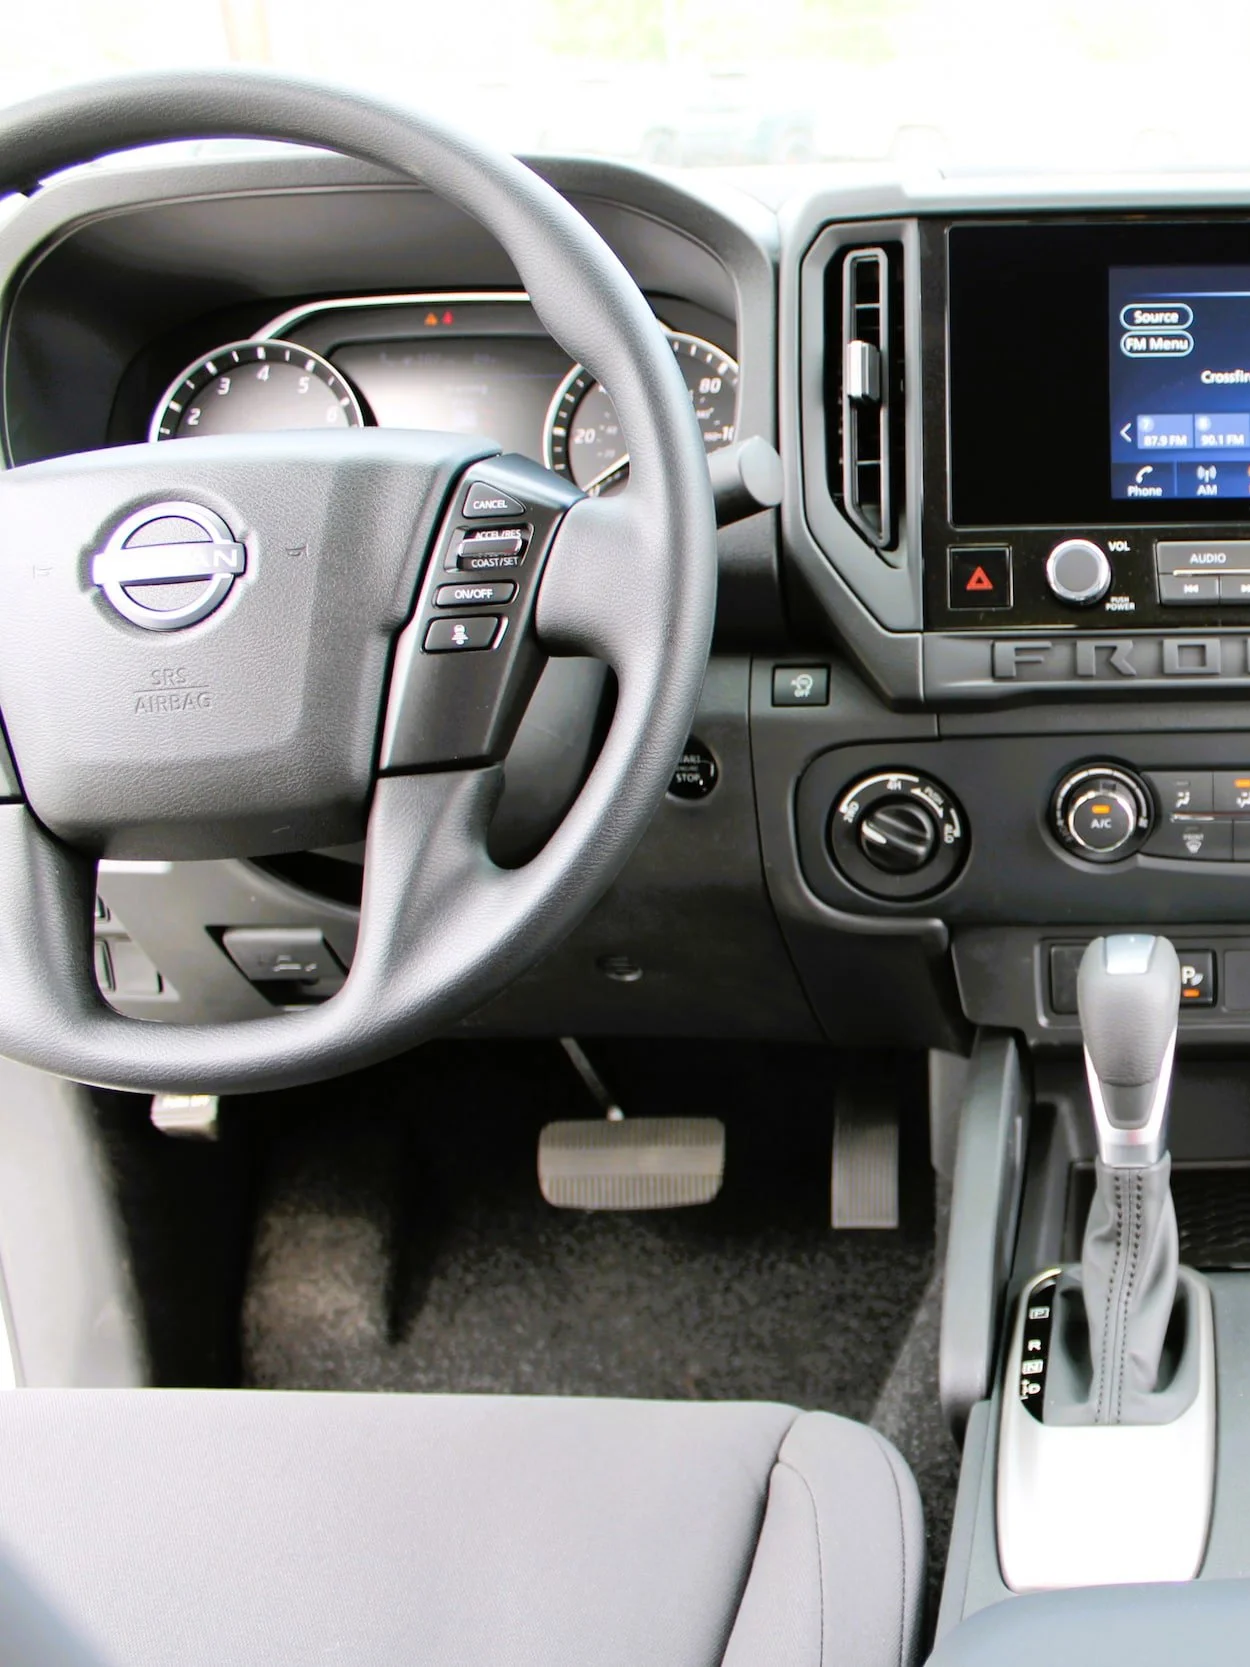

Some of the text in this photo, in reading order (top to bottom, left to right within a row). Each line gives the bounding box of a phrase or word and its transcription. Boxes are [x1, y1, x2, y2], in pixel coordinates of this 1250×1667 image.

[1133, 310, 1179, 325] Source
[1125, 336, 1189, 351] FM Menu
[256, 365, 270, 381] 4
[217, 377, 231, 395] 3
[297, 376, 310, 393] 5
[699, 377, 722, 394] 80
[187, 408, 201, 425] 2
[574, 428, 596, 444] 20
[1169, 434, 1187, 445] FM
[1226, 433, 1245, 445] FM
[1127, 485, 1163, 497] Phone
[1196, 484, 1218, 496] AM
[473, 500, 508, 510] CANCEL
[475, 529, 522, 539] ACCEL/RES
[1107, 540, 1131, 552] VOL
[471, 557, 518, 568] COAST/SET
[1189, 553, 1227, 564] AUDIO
[454, 588, 494, 600] ON/OFF
[1105, 602, 1136, 611] POWER
[151, 668, 188, 686] SRS
[135, 691, 214, 714] AIRBAG
[1091, 818, 1113, 830] A/C
[1028, 1339, 1042, 1352] R
